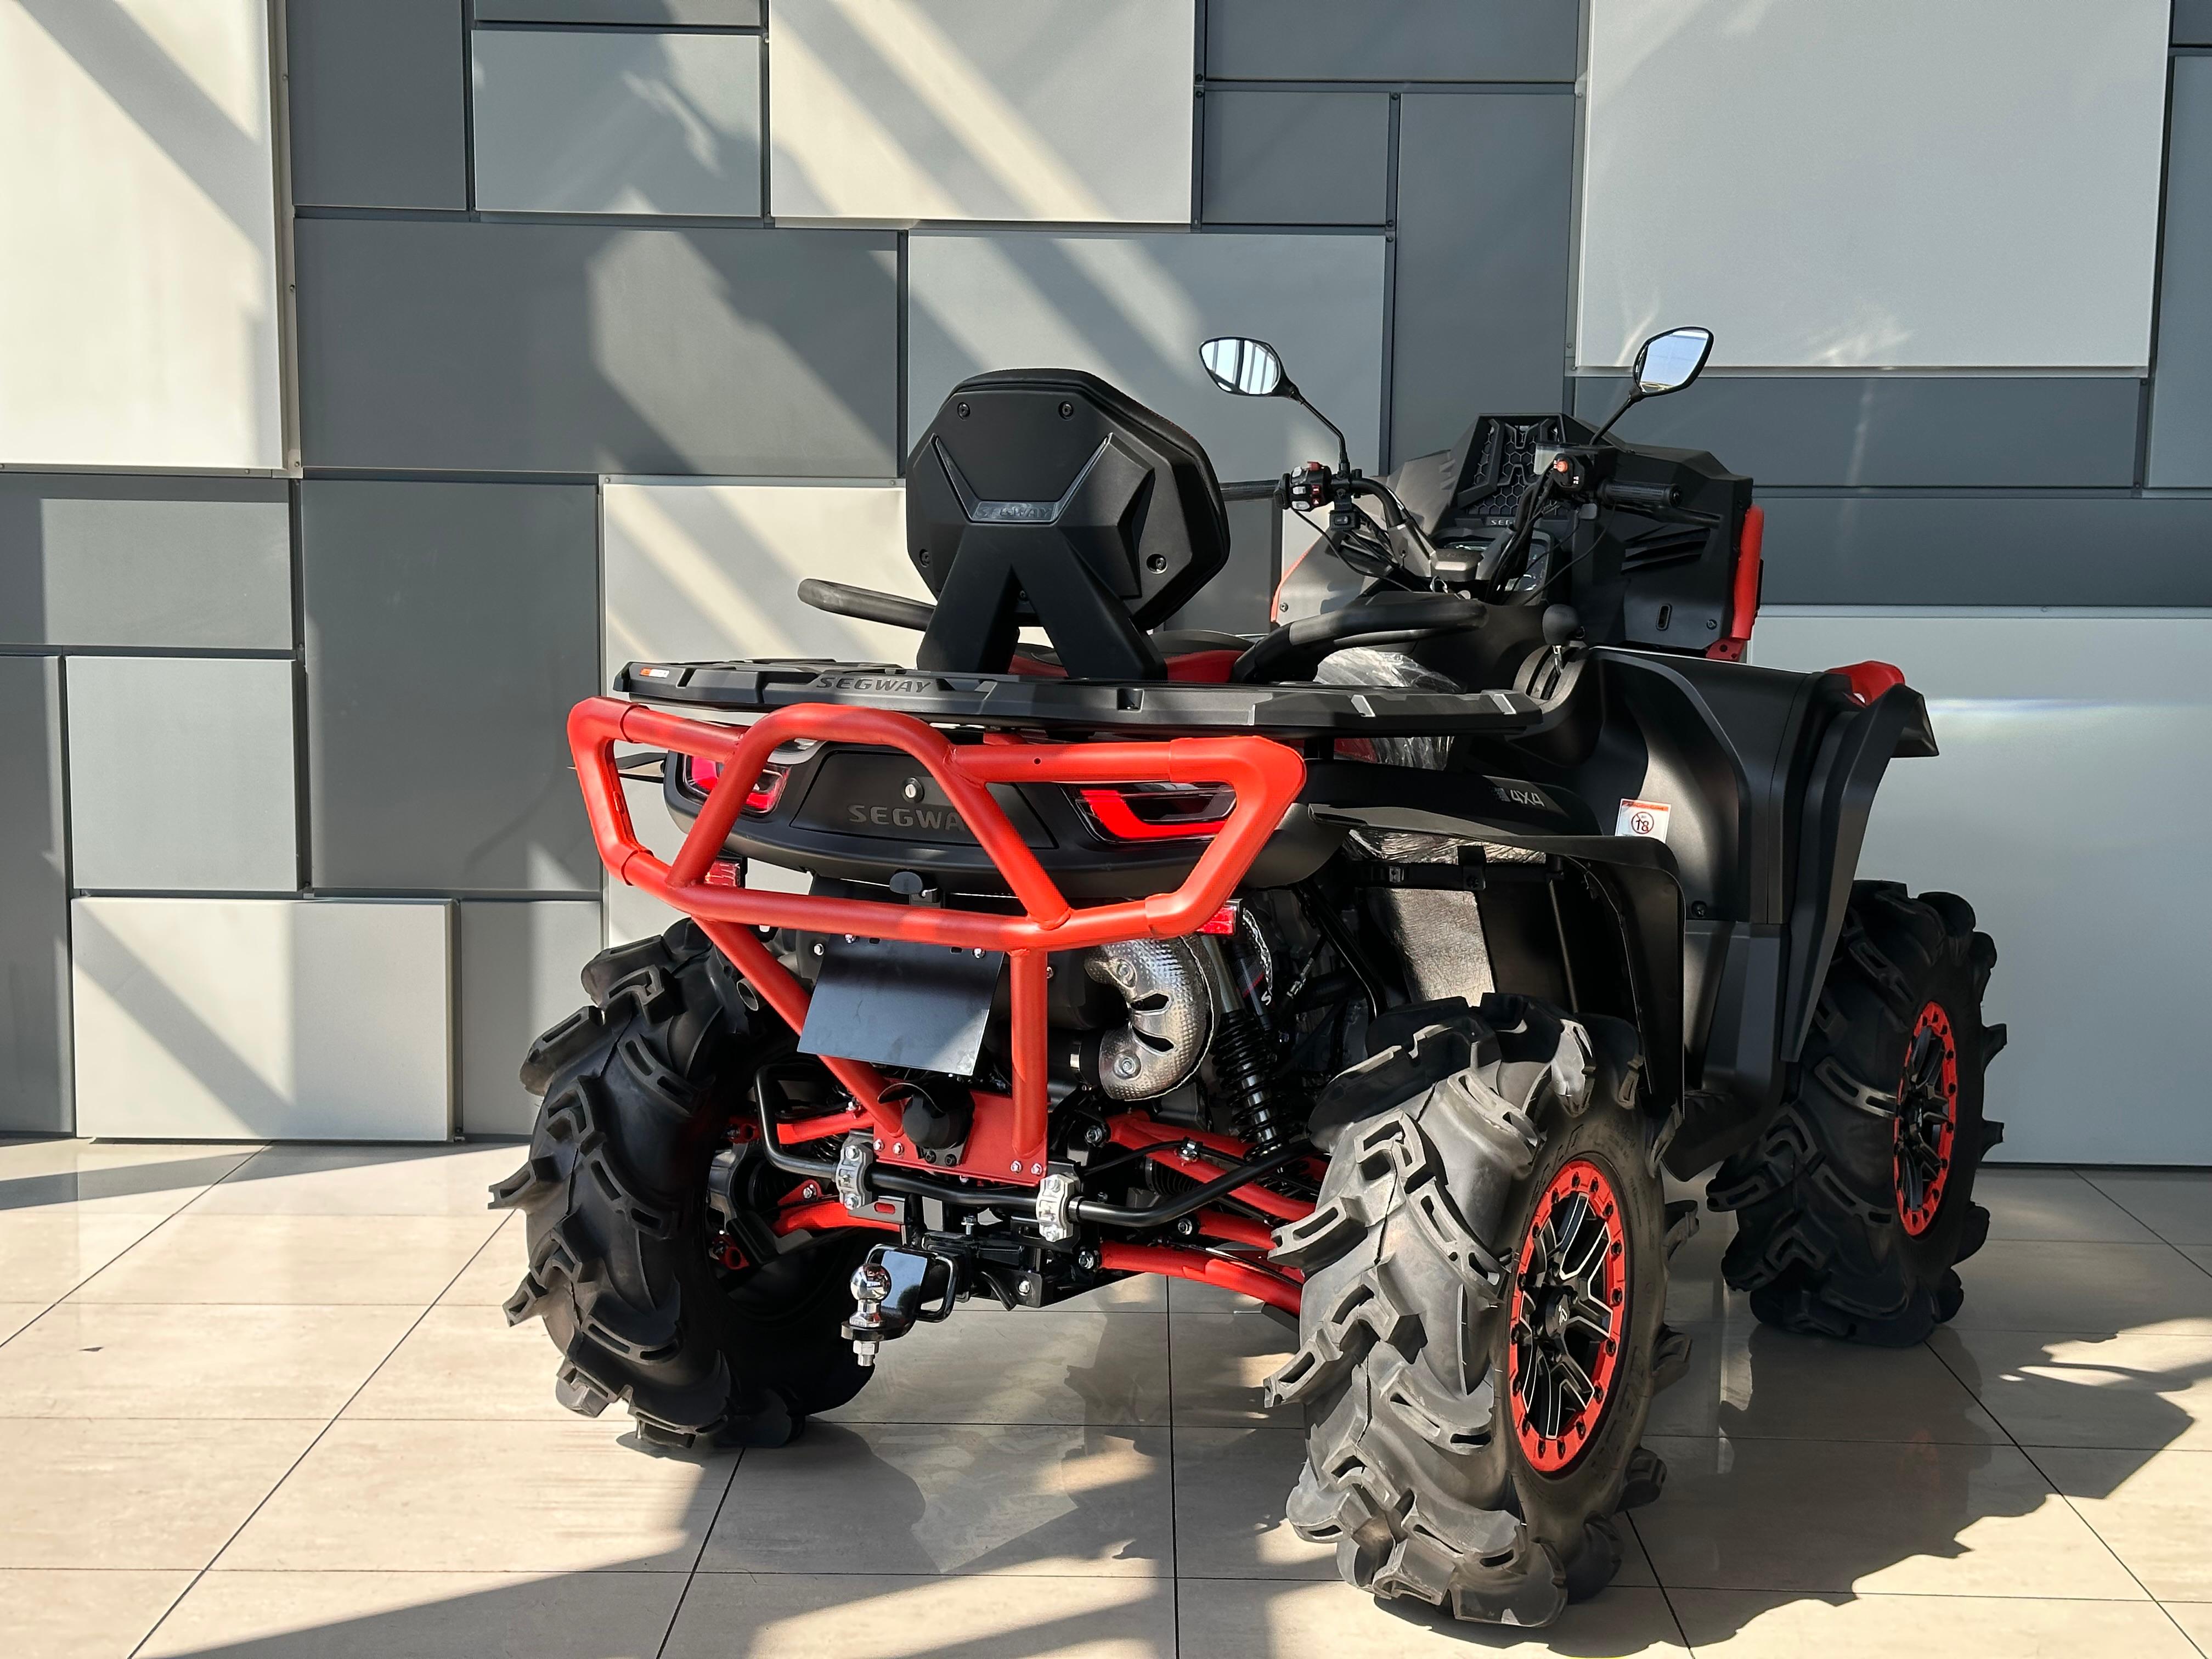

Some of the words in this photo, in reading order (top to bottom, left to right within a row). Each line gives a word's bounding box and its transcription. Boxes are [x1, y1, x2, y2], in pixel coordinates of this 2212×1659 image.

[816, 677, 932, 693] SEGWAY
[847, 804, 966, 831] SEGWA
[1635, 819, 1649, 832] 18
